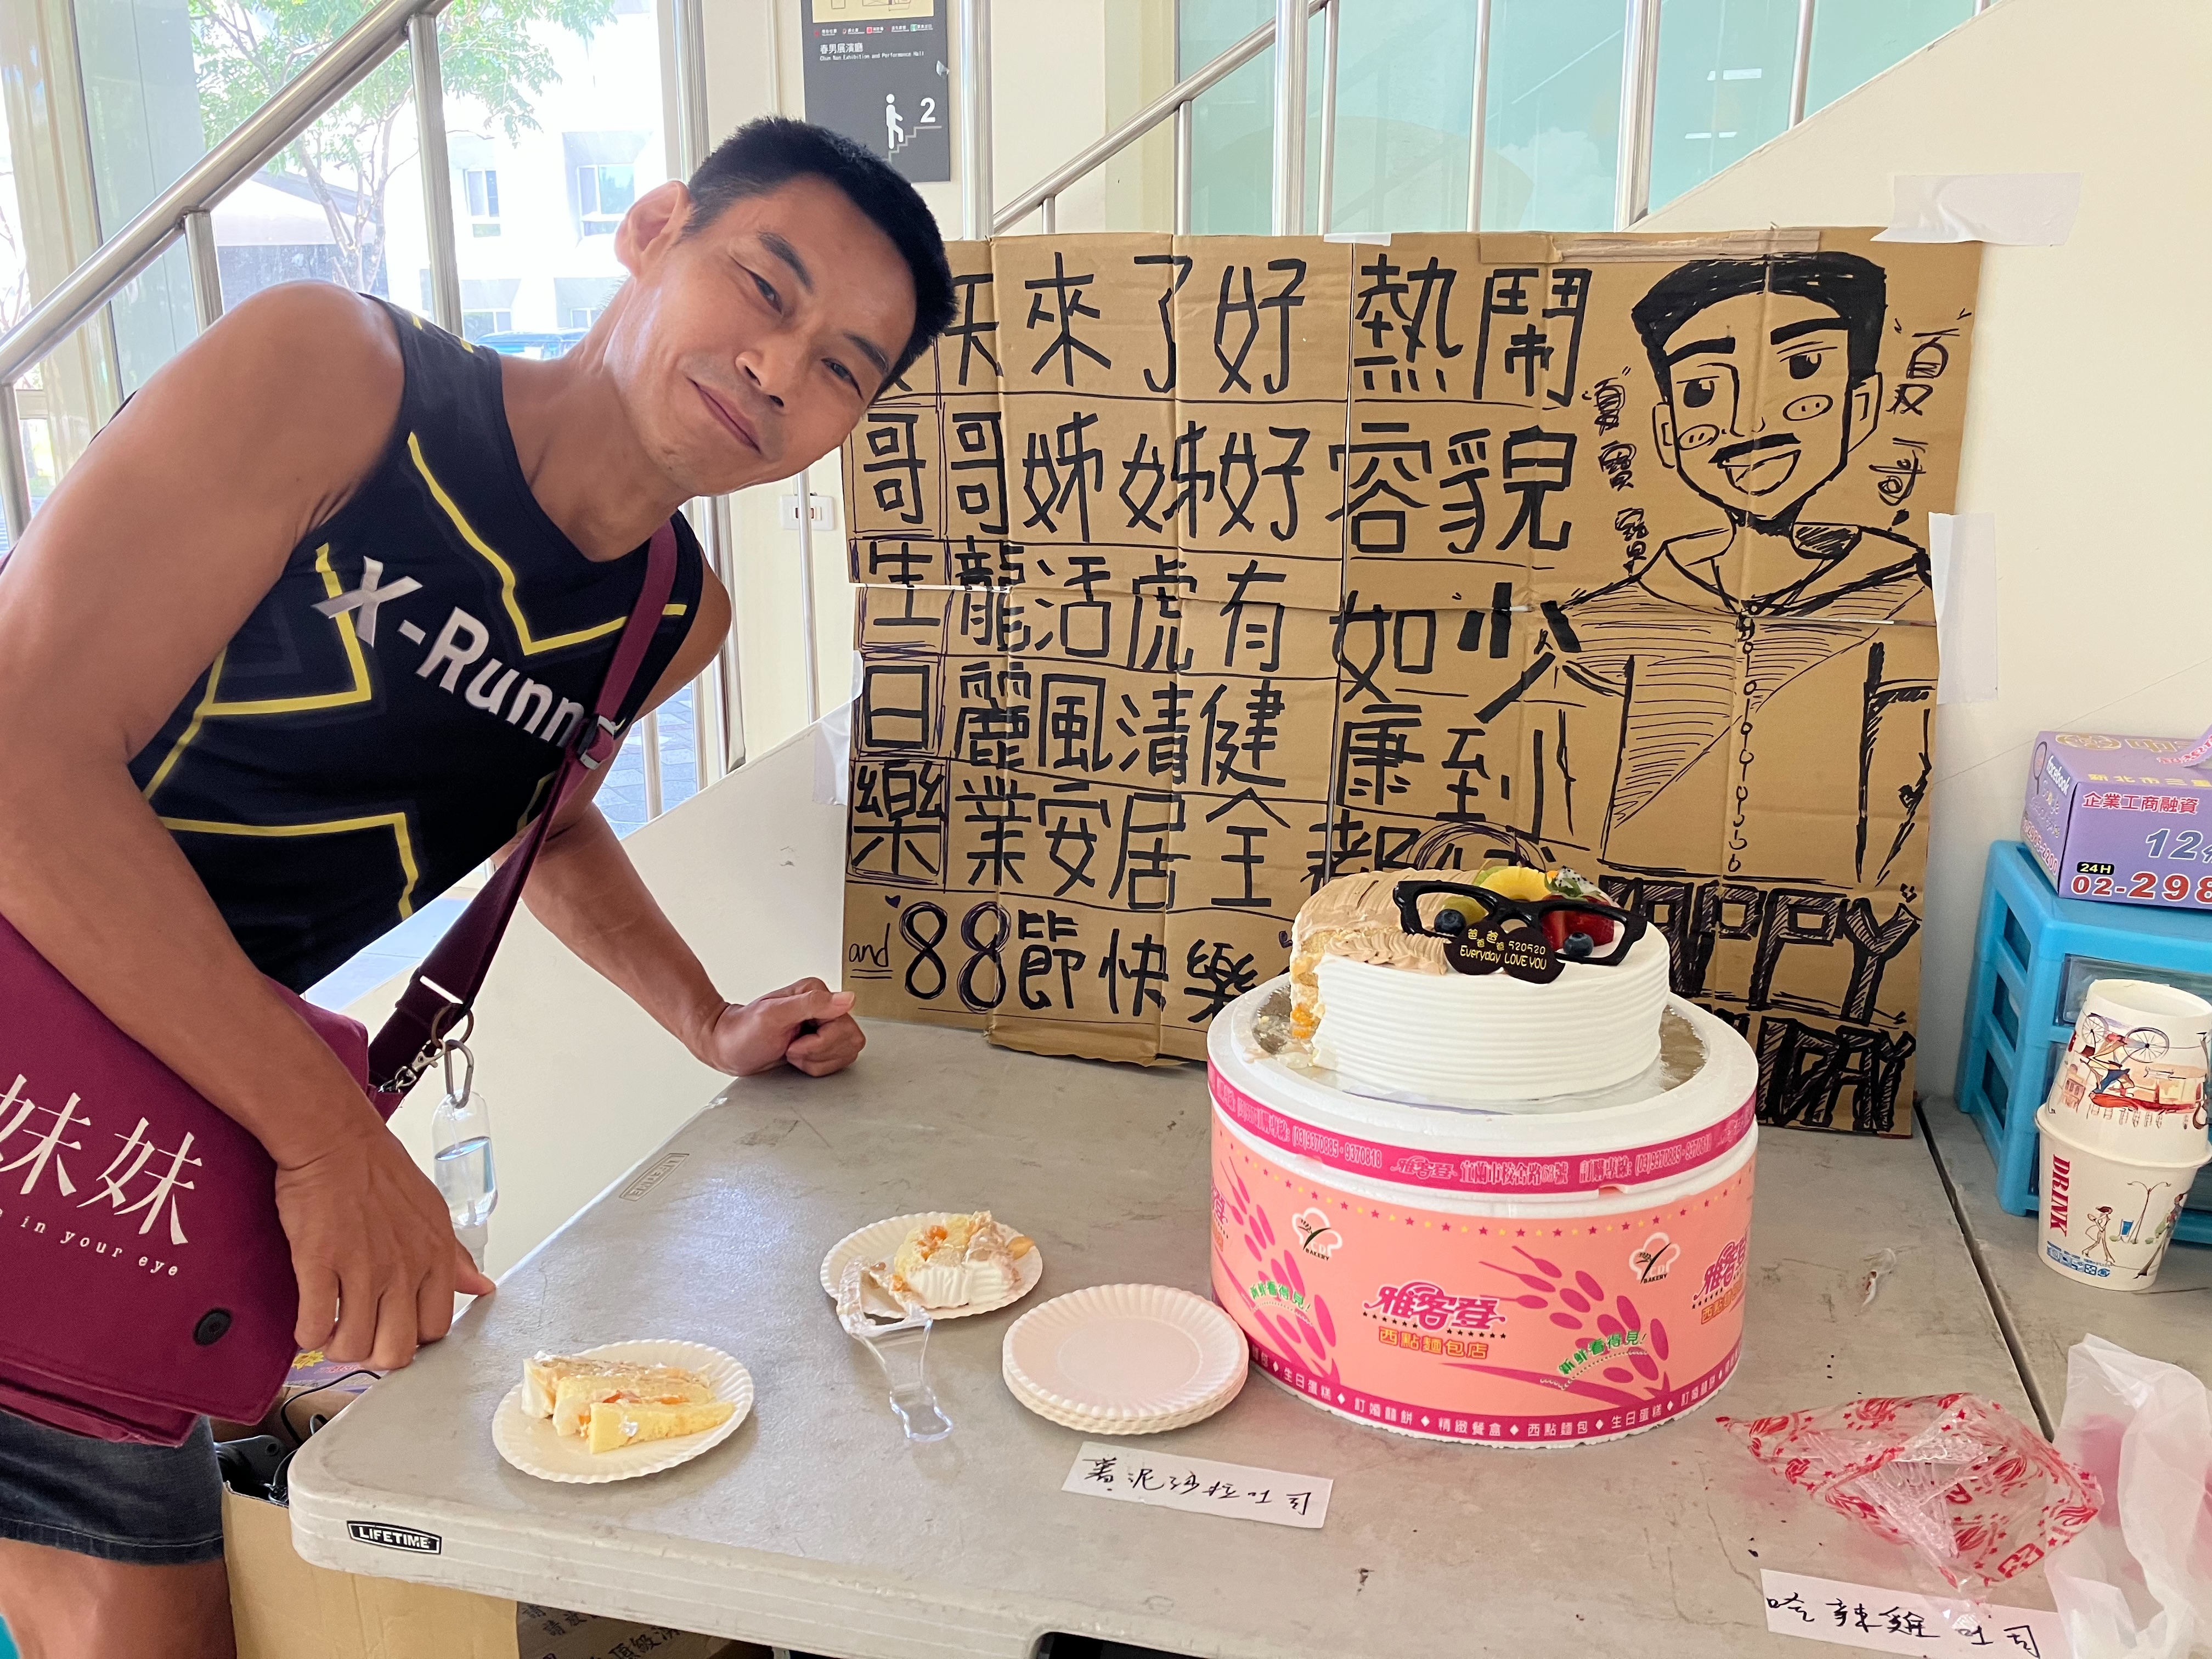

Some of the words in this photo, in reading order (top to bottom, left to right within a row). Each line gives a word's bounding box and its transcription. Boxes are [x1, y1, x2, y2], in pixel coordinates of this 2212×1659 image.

[920, 97, 936, 123] 2
[893, 251, 1593, 407] 天來了好熱鬧
[2046, 755, 2072, 797] facebook
[2082, 791, 2199, 815] 企業工商融資
[2079, 863, 2112, 874] 24H
[848, 923, 890, 968] and
[1459, 945, 1502, 964] Everyday
[1504, 953, 1528, 967] LOVE
[1529, 956, 1547, 970] YOU
[1508, 940, 1547, 955] 520520
[0, 1074, 202, 1245] 妹妹
[2050, 1153, 2070, 1237] DRINK
[20, 1216, 47, 1234] in
[60, 1231, 123, 1258] your
[138, 1256, 178, 1277] eye
[1305, 1248, 1330, 1262] BAKERY
[1643, 1273, 1668, 1284] BAKERY
[1362, 1279, 1506, 1332] 雅客登
[1378, 1326, 1489, 1360] 西點麵包店
[1283, 1367, 1331, 1402] 生日蛋糕
[1527, 1420, 1588, 1437] 西點麵包
[1611, 1402, 1663, 1429] 生日蛋糕
[358, 1526, 431, 1550] LIFETIME
